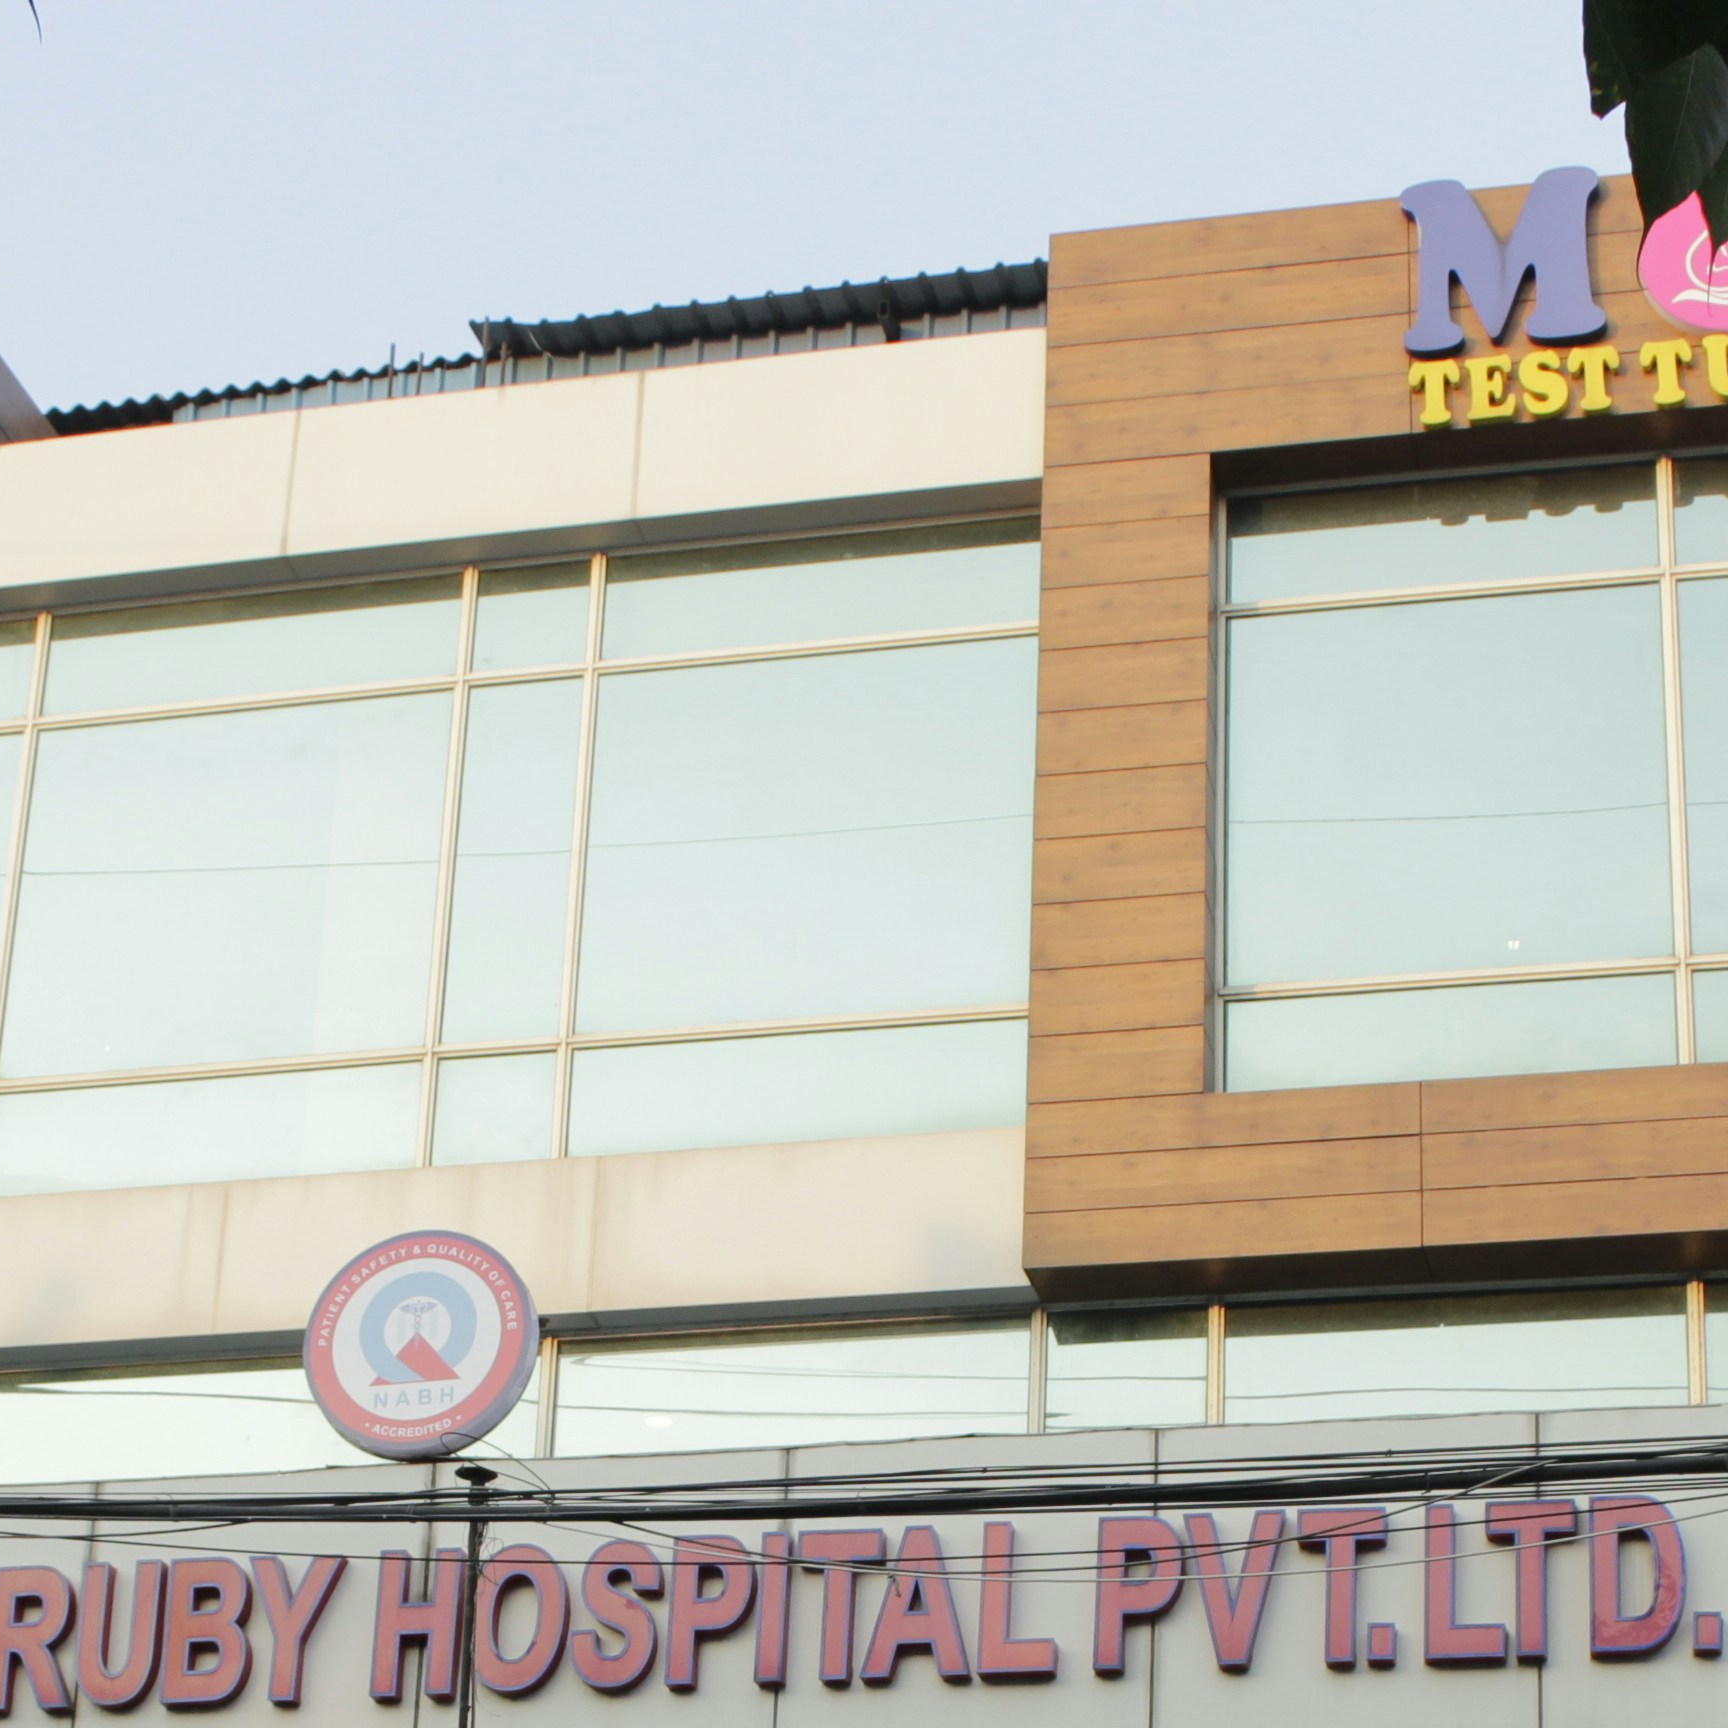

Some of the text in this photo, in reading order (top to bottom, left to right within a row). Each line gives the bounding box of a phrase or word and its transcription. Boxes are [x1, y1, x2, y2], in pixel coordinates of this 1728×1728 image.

[1408, 345, 1619, 428] TEST
[317, 1285, 353, 1347] PATIENT
[351, 1245, 408, 1284] SAFETY
[427, 1243, 490, 1272] QUALITY
[501, 1289, 518, 1331] CARE
[371, 1417, 452, 1438] ACCREDITED
[373, 1386, 455, 1409] NABH
[368, 1521, 1059, 1706] HOSPITAL
[1092, 1506, 1397, 1682] PVT.
[1424, 1493, 1722, 1670] LTD.
